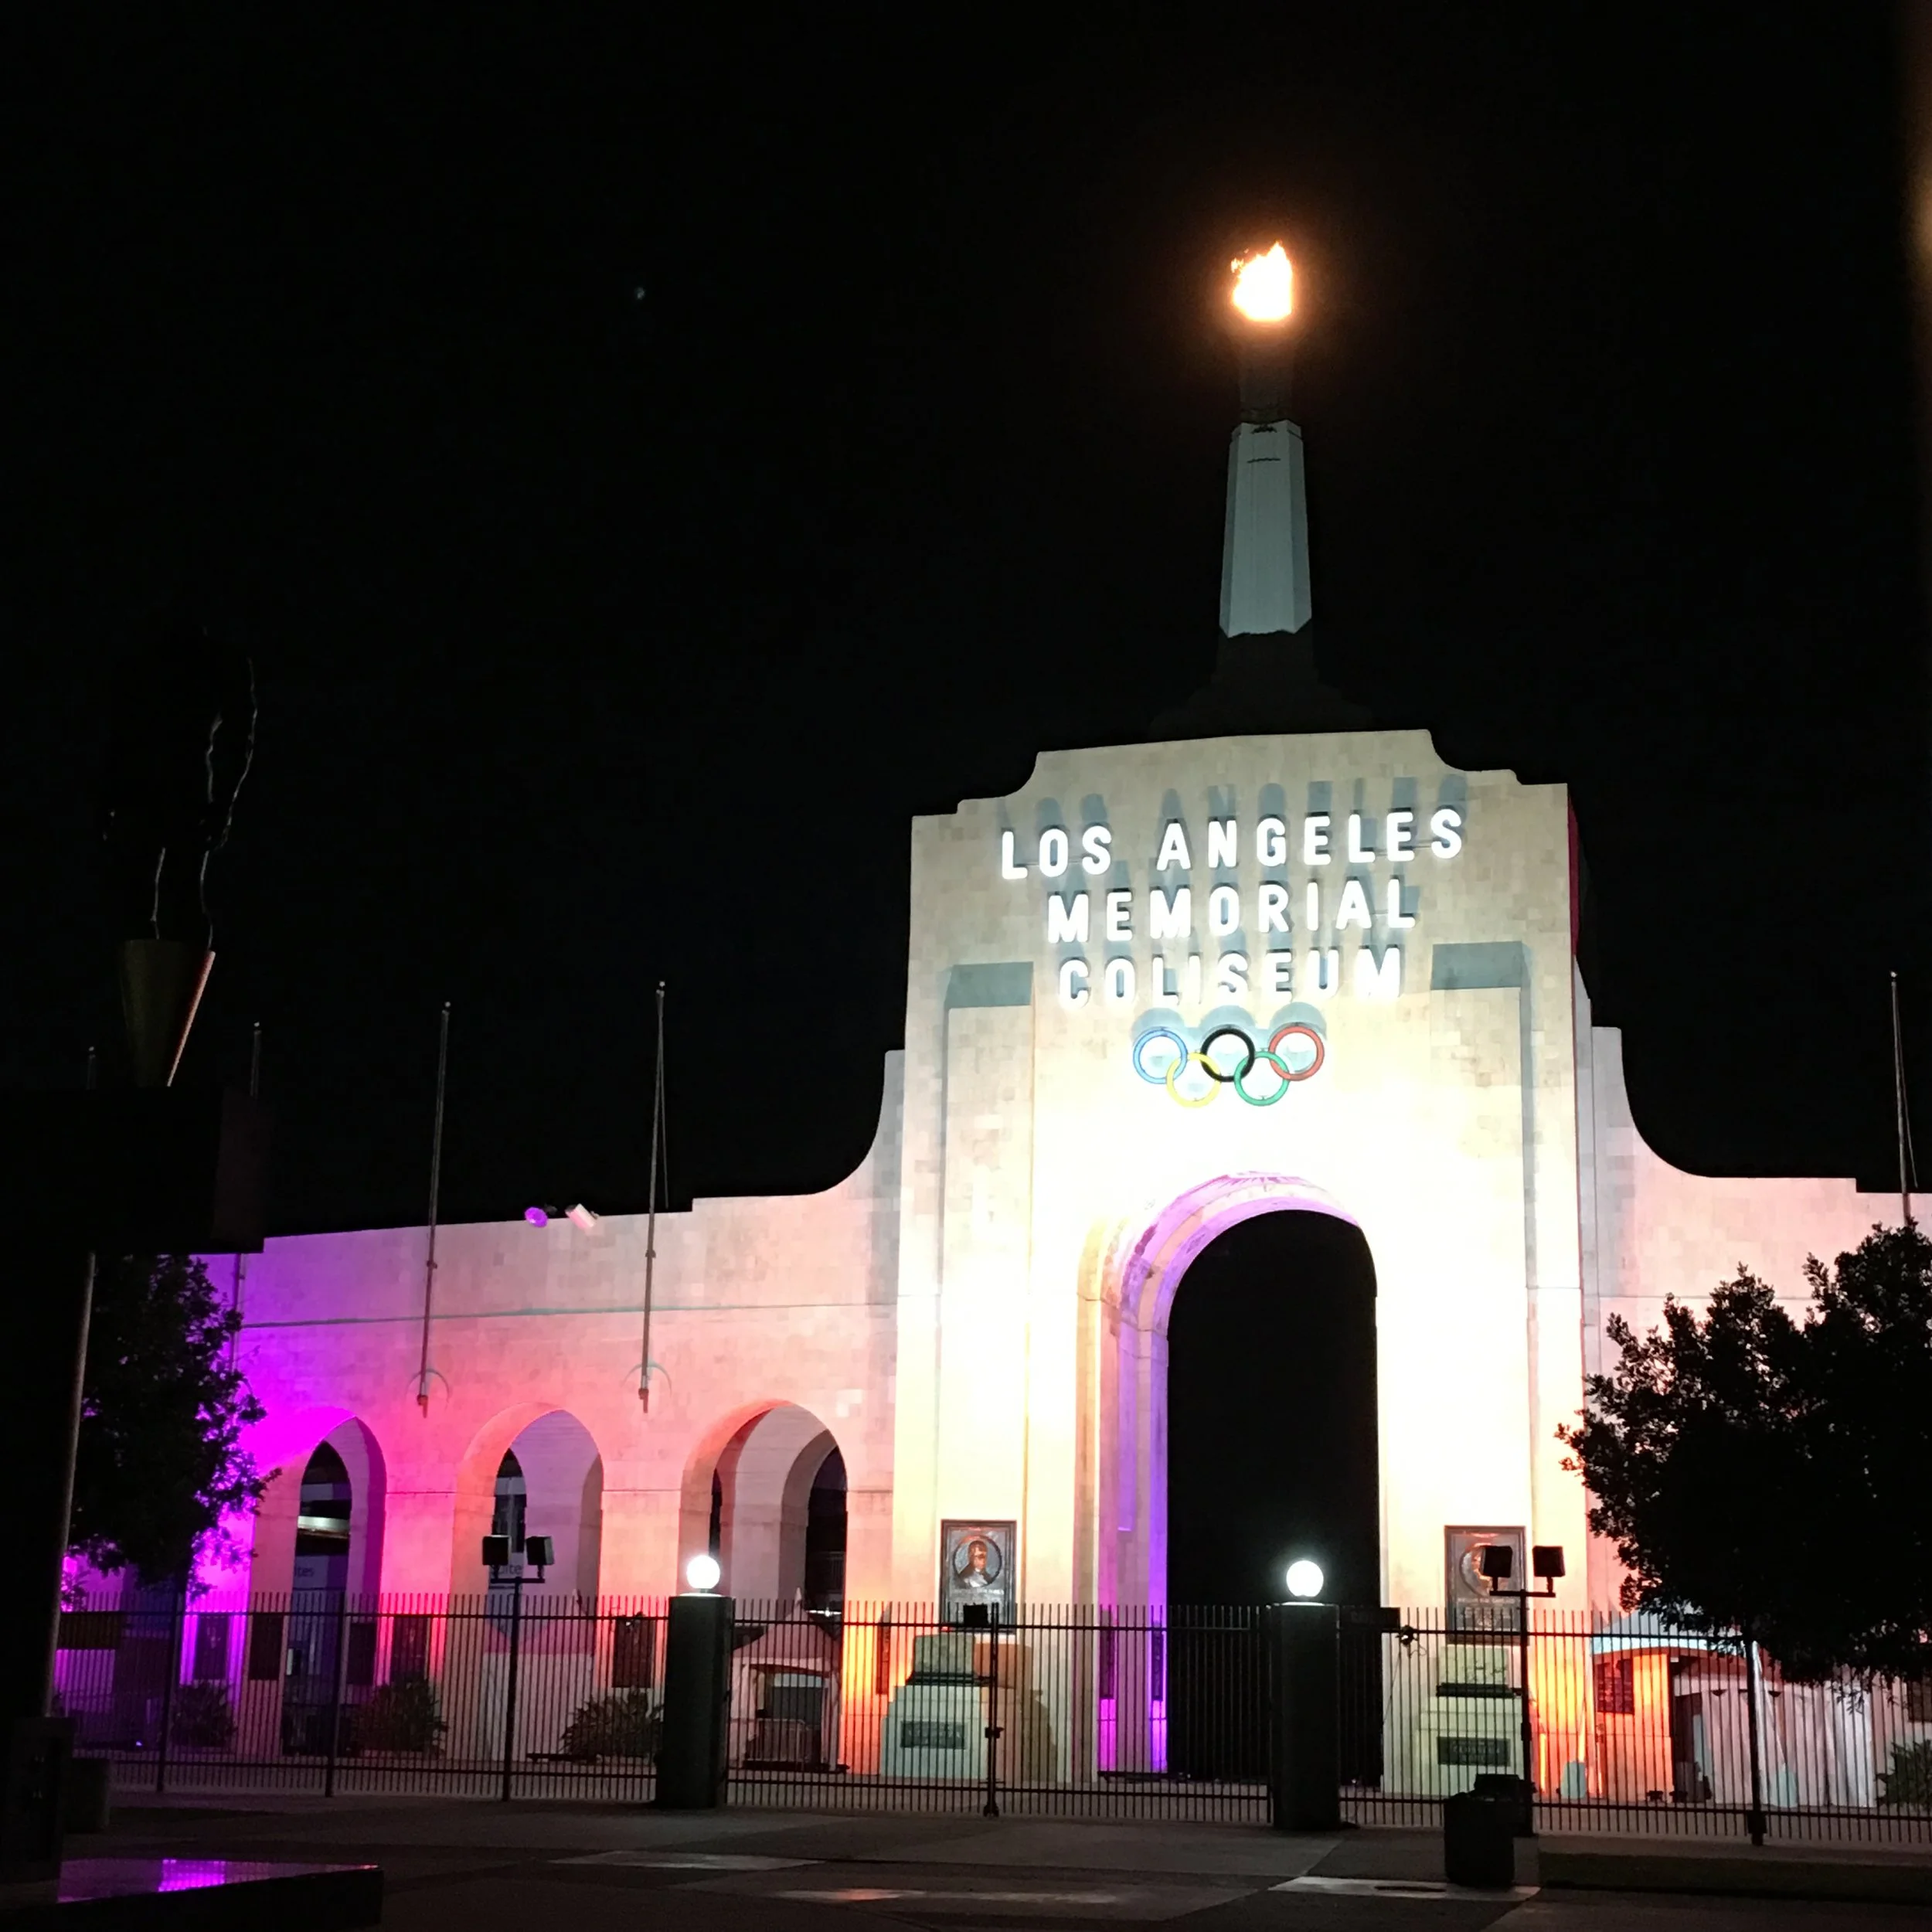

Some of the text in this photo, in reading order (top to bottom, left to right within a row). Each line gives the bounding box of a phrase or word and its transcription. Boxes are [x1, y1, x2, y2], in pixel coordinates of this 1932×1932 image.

[1001, 808, 1463, 880] LOS ANGELES
[1047, 878, 1416, 944] MEMORIAL
[1059, 947, 1403, 1008] COLISEUM
